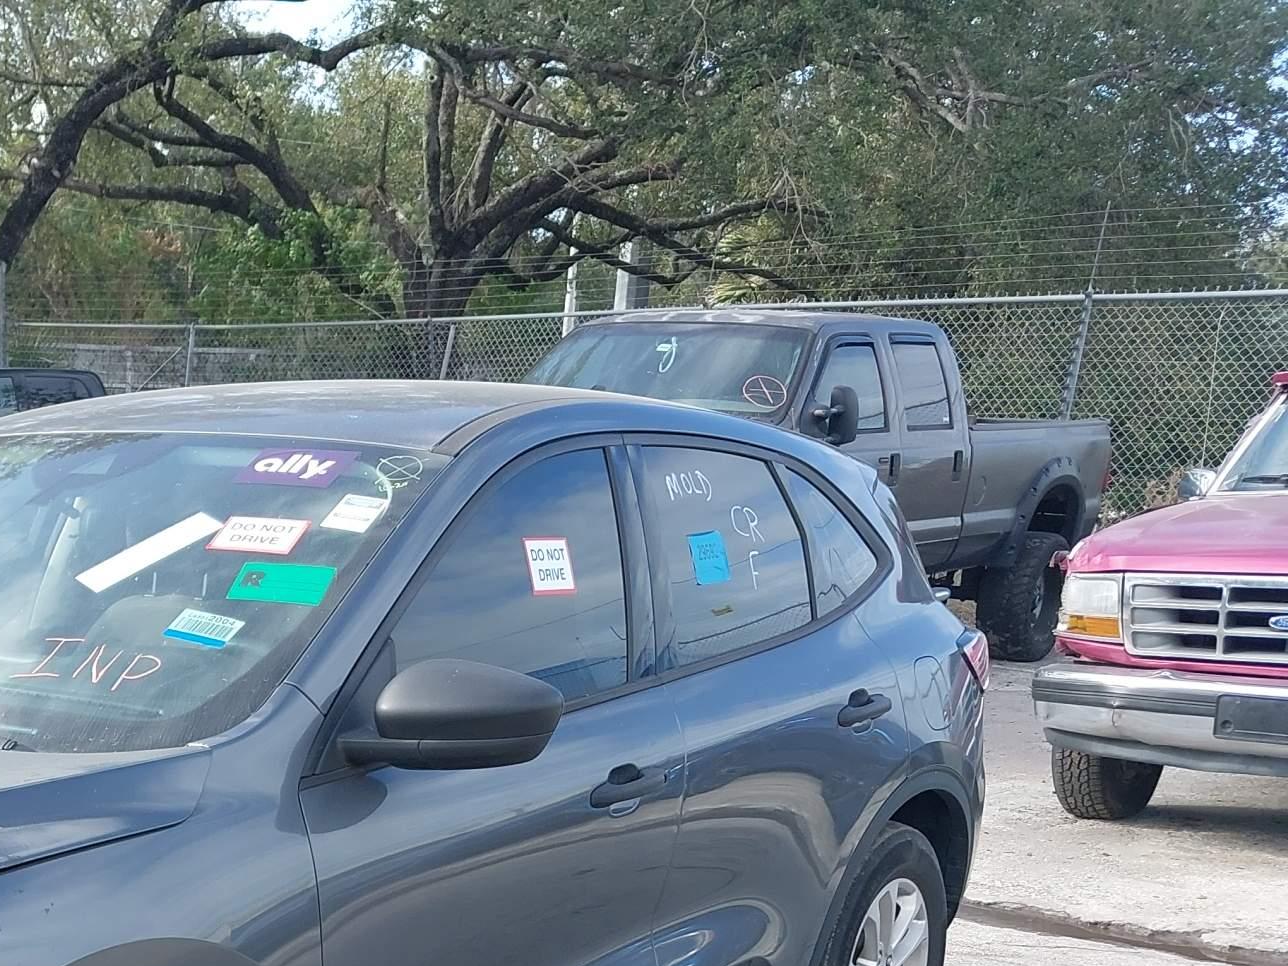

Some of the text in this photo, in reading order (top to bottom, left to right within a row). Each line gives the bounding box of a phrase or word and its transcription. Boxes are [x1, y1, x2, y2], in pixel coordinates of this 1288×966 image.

[665, 470, 712, 501] MOLD
[231, 522, 298, 534] DO NOT
[730, 505, 765, 543] CR
[229, 534, 281, 545] DRIVE
[530, 548, 565, 561] DO NOT
[538, 567, 567, 582] DRIVE
[749, 550, 759, 590] F
[8, 637, 162, 692] INP
